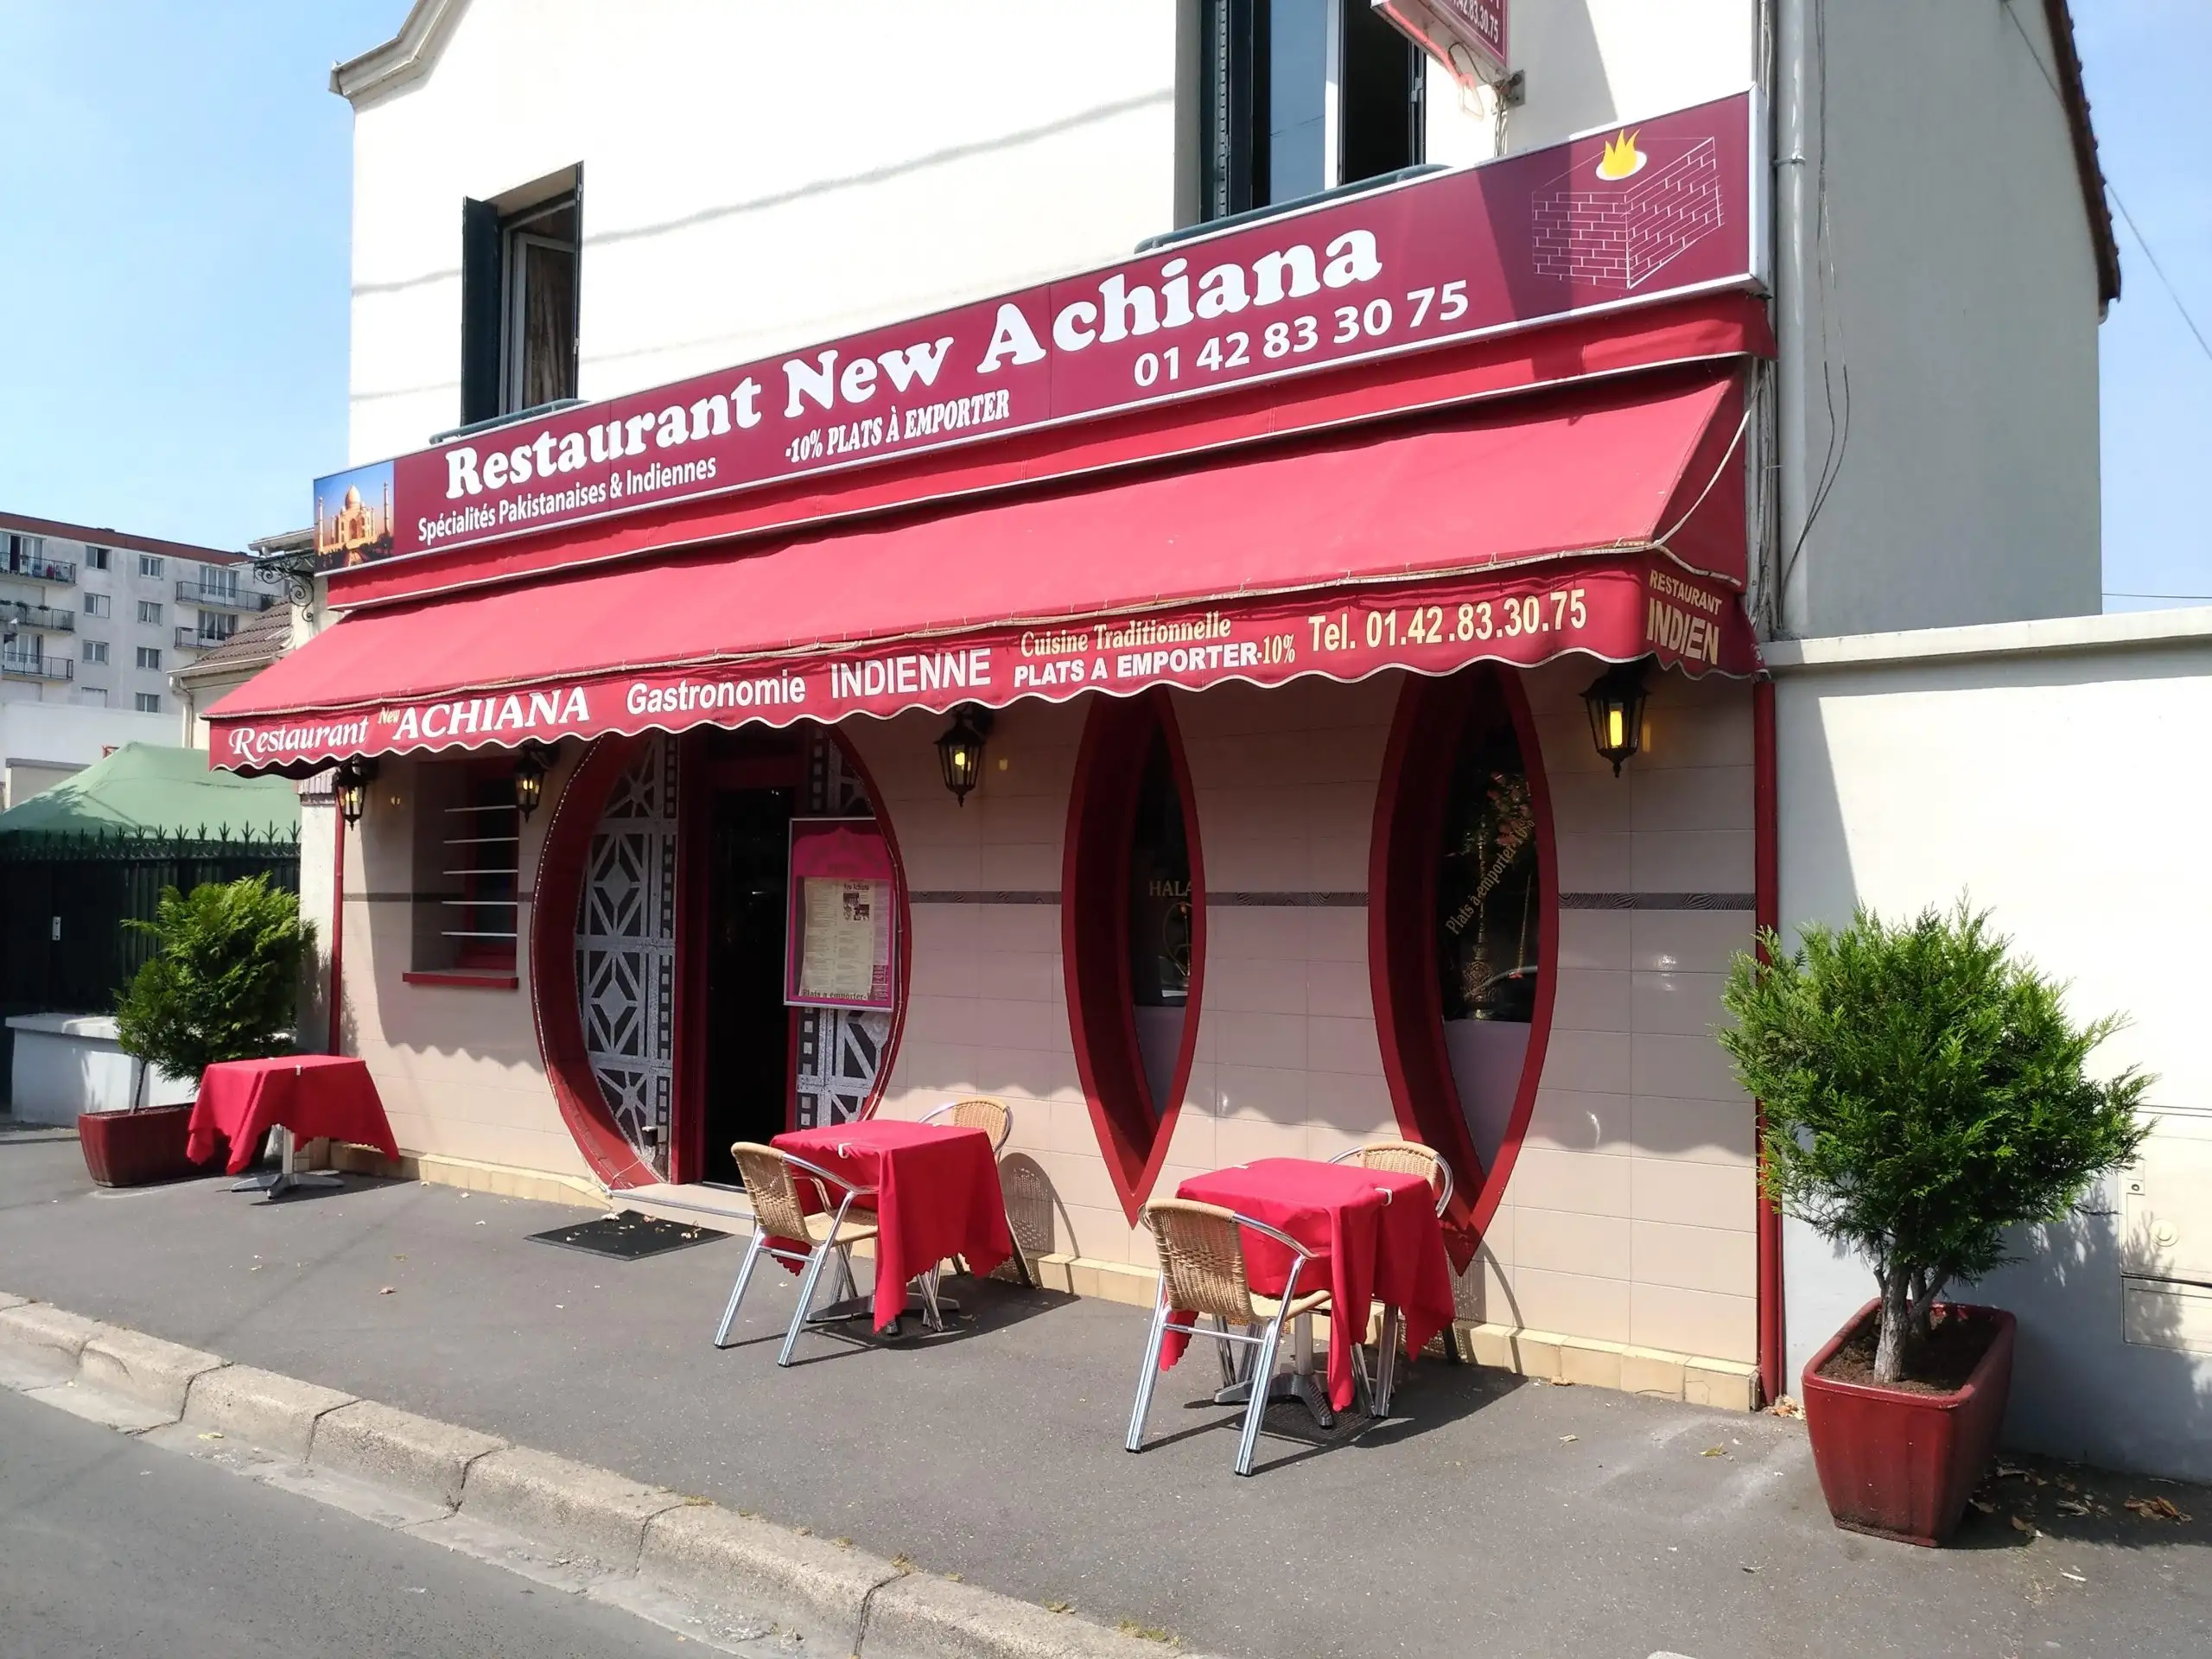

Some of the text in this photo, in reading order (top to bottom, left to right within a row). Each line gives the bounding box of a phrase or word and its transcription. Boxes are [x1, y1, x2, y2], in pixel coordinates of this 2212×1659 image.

[1134, 280, 1469, 387] 01 42 83 30 75
[445, 229, 1382, 499] Restaurant New Achiana
[785, 389, 1010, 463] -10% PLATS À EMPORTER
[418, 456, 716, 545] Spécialités Pakistanaises & Indiennes
[1649, 569, 1723, 615] RESTAURANT
[1020, 610, 1231, 658] Cuisine Traditionnelle
[1308, 613, 1356, 652] Tel.
[1646, 597, 1719, 665] INDIEN
[626, 669, 806, 715] Gastronomie
[830, 648, 992, 699] INDIENNE
[1014, 658, 1085, 688] PLATS
[1090, 657, 1108, 680] A
[229, 716, 369, 762] Restaurant
[378, 686, 590, 741] New ACHIANA
